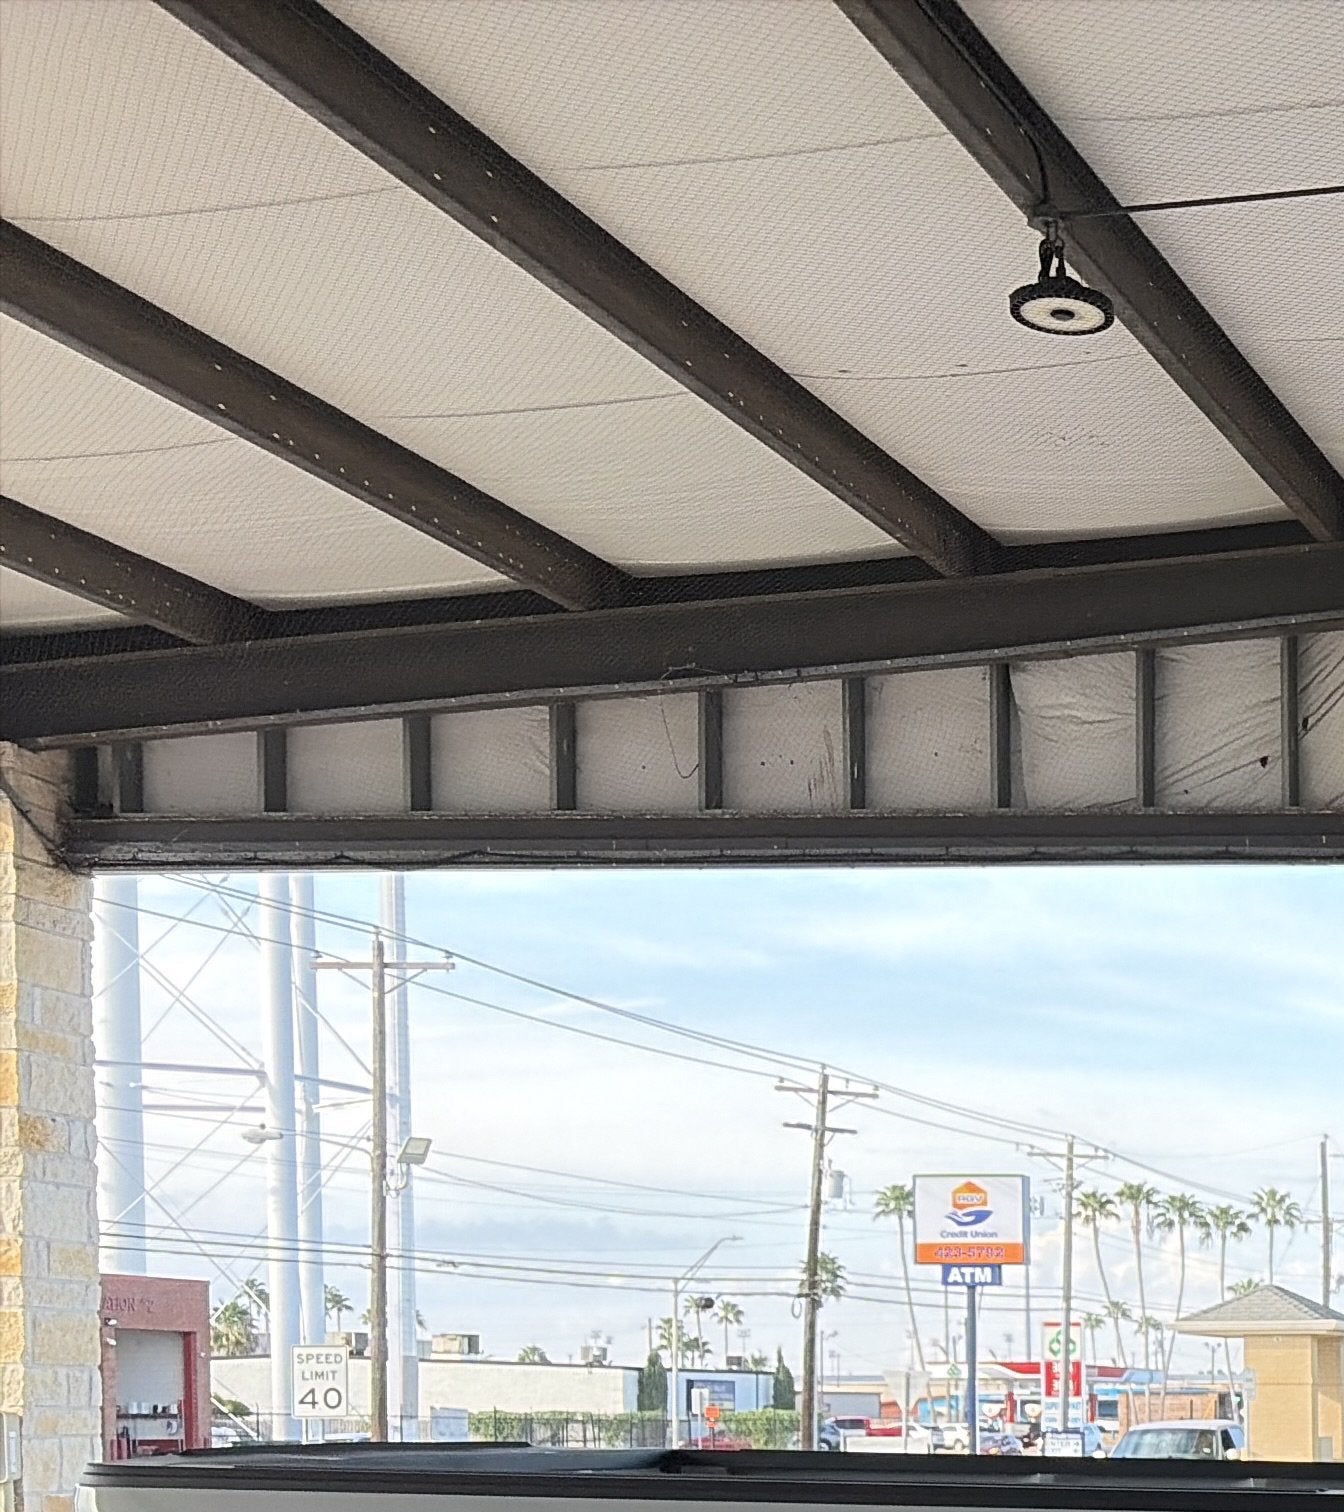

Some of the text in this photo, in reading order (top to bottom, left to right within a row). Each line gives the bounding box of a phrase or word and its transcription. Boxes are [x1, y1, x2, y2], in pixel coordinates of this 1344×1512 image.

[940, 1230, 998, 1239] Credit Union
[947, 1266, 992, 1283] ATM
[296, 1353, 343, 1364] SPEED
[301, 1370, 338, 1381] LIMIT
[298, 1387, 343, 1409] 40
